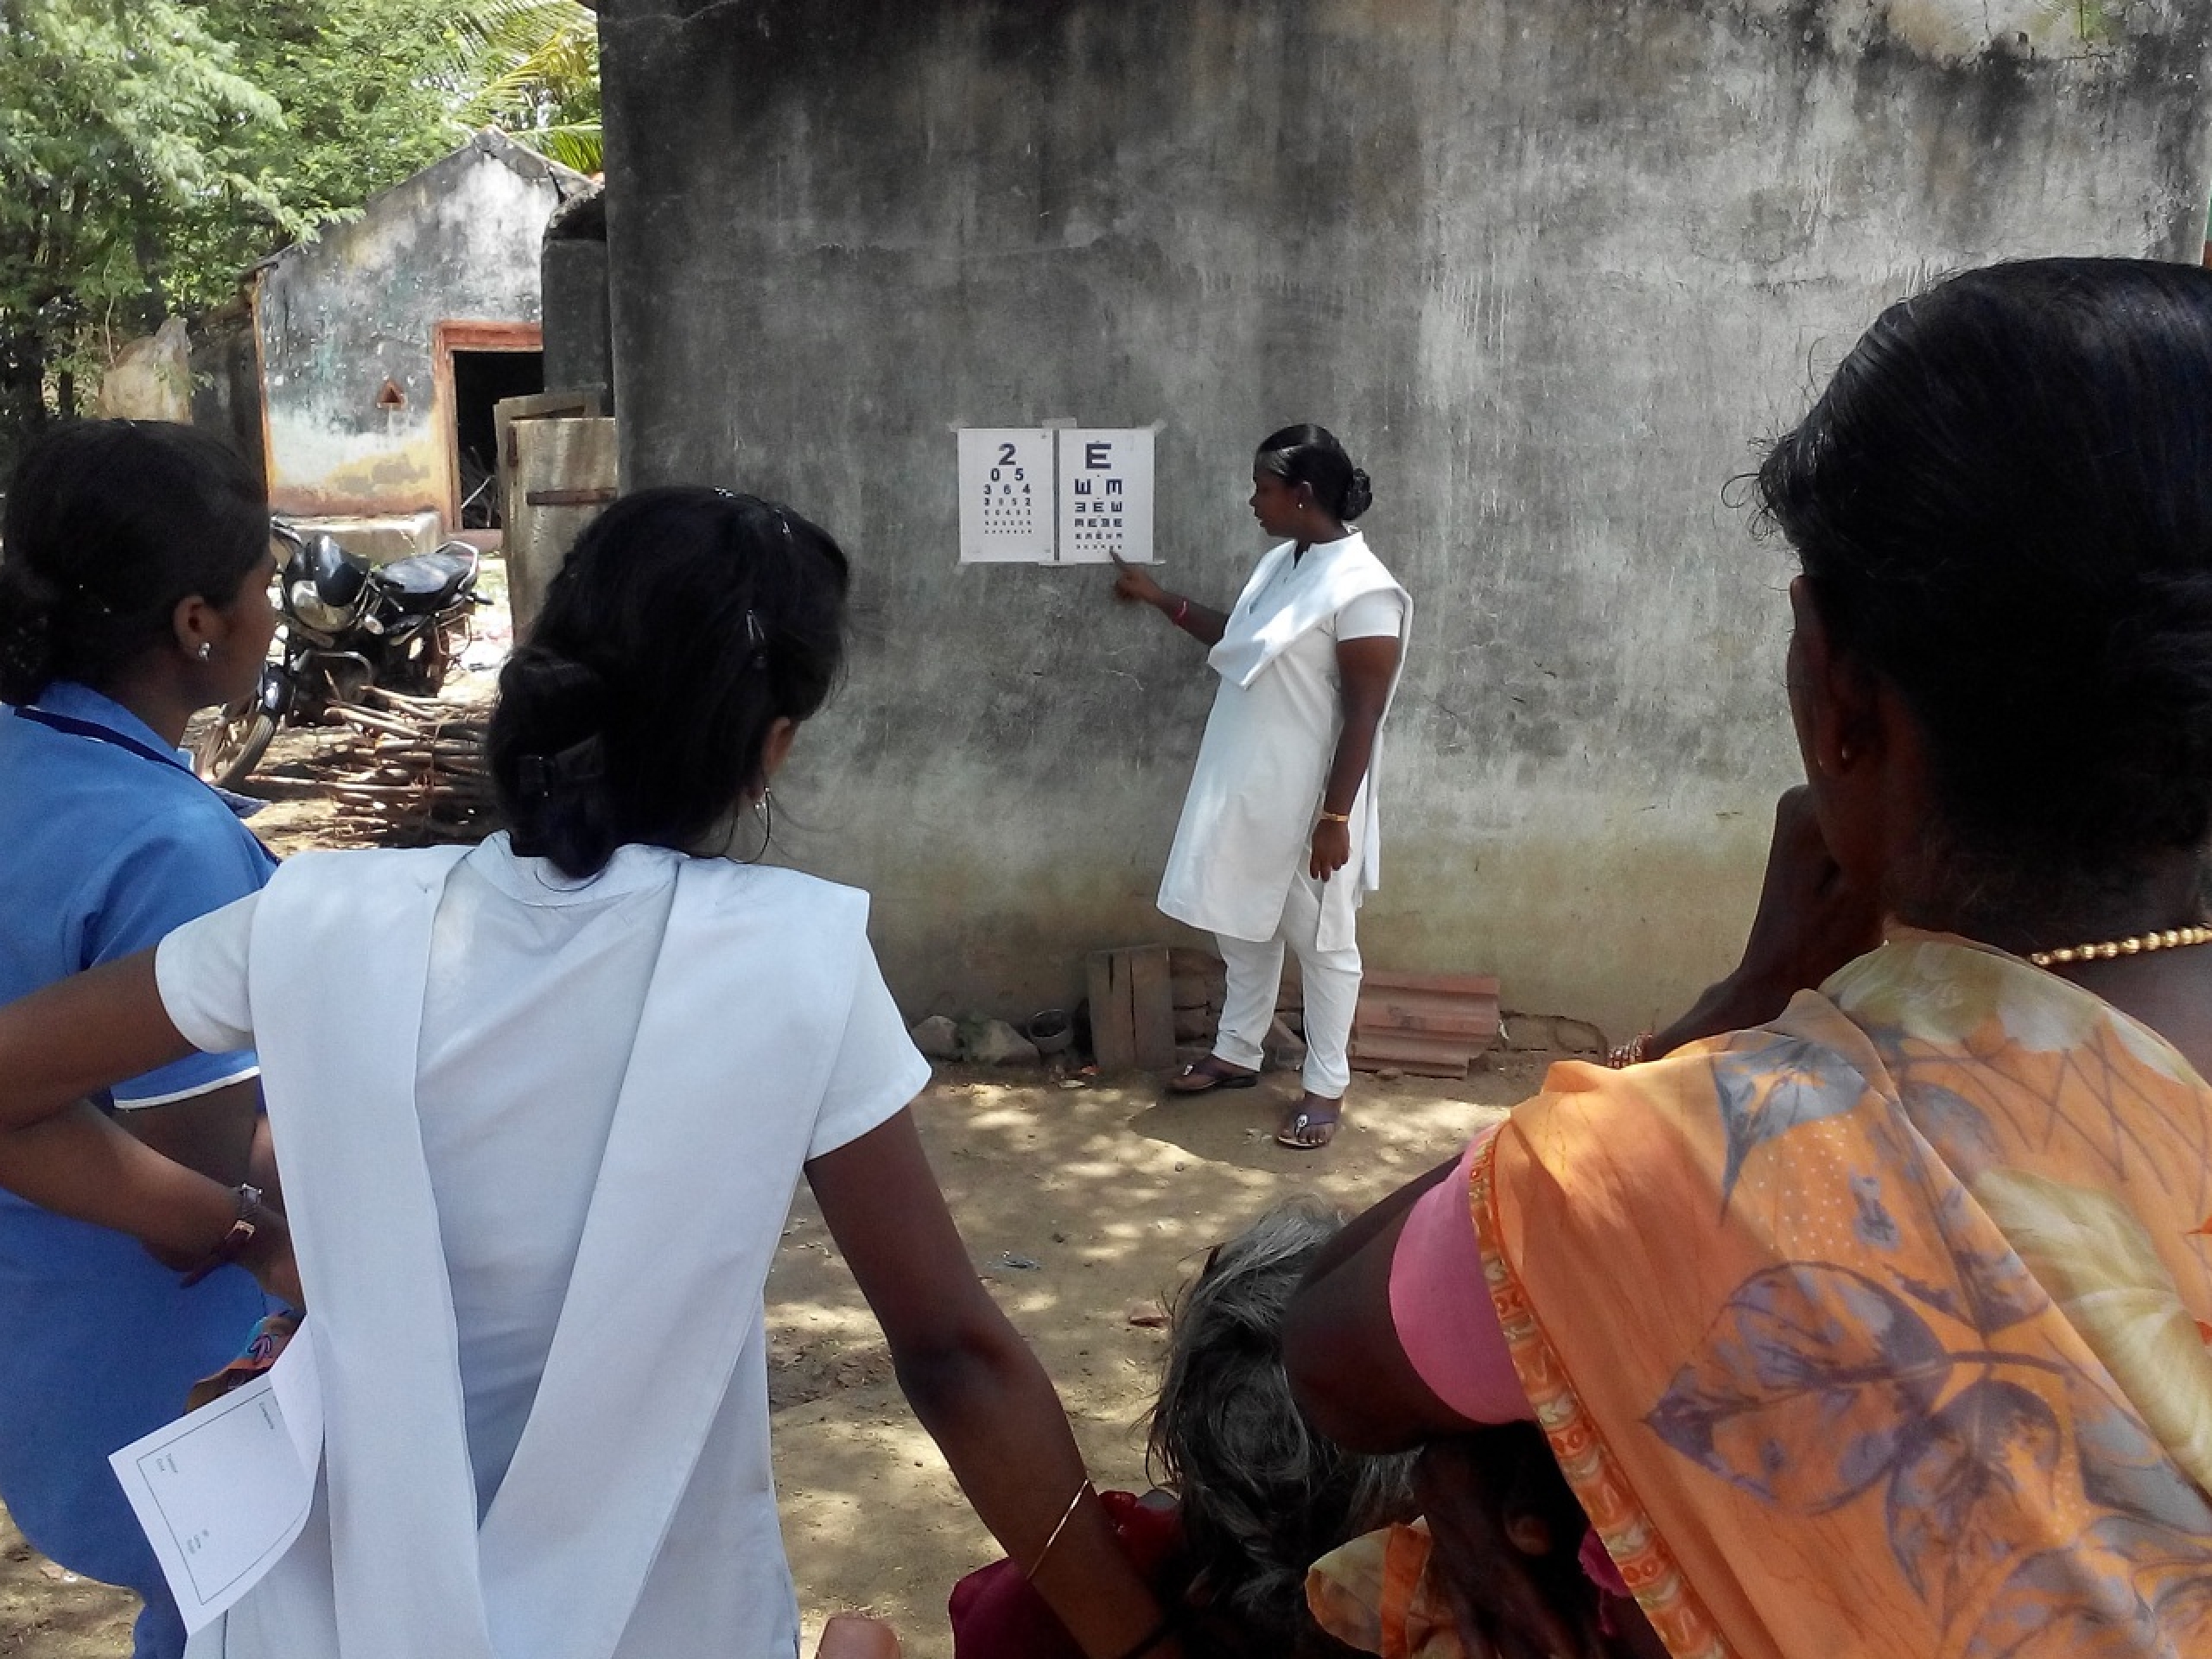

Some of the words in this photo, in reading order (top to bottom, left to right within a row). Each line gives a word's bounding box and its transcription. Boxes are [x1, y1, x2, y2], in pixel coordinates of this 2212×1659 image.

[999, 442, 1017, 466] 2
[1085, 443, 1112, 469] E
[1014, 468, 1024, 481] 5
[1022, 484, 1031, 495] 4
